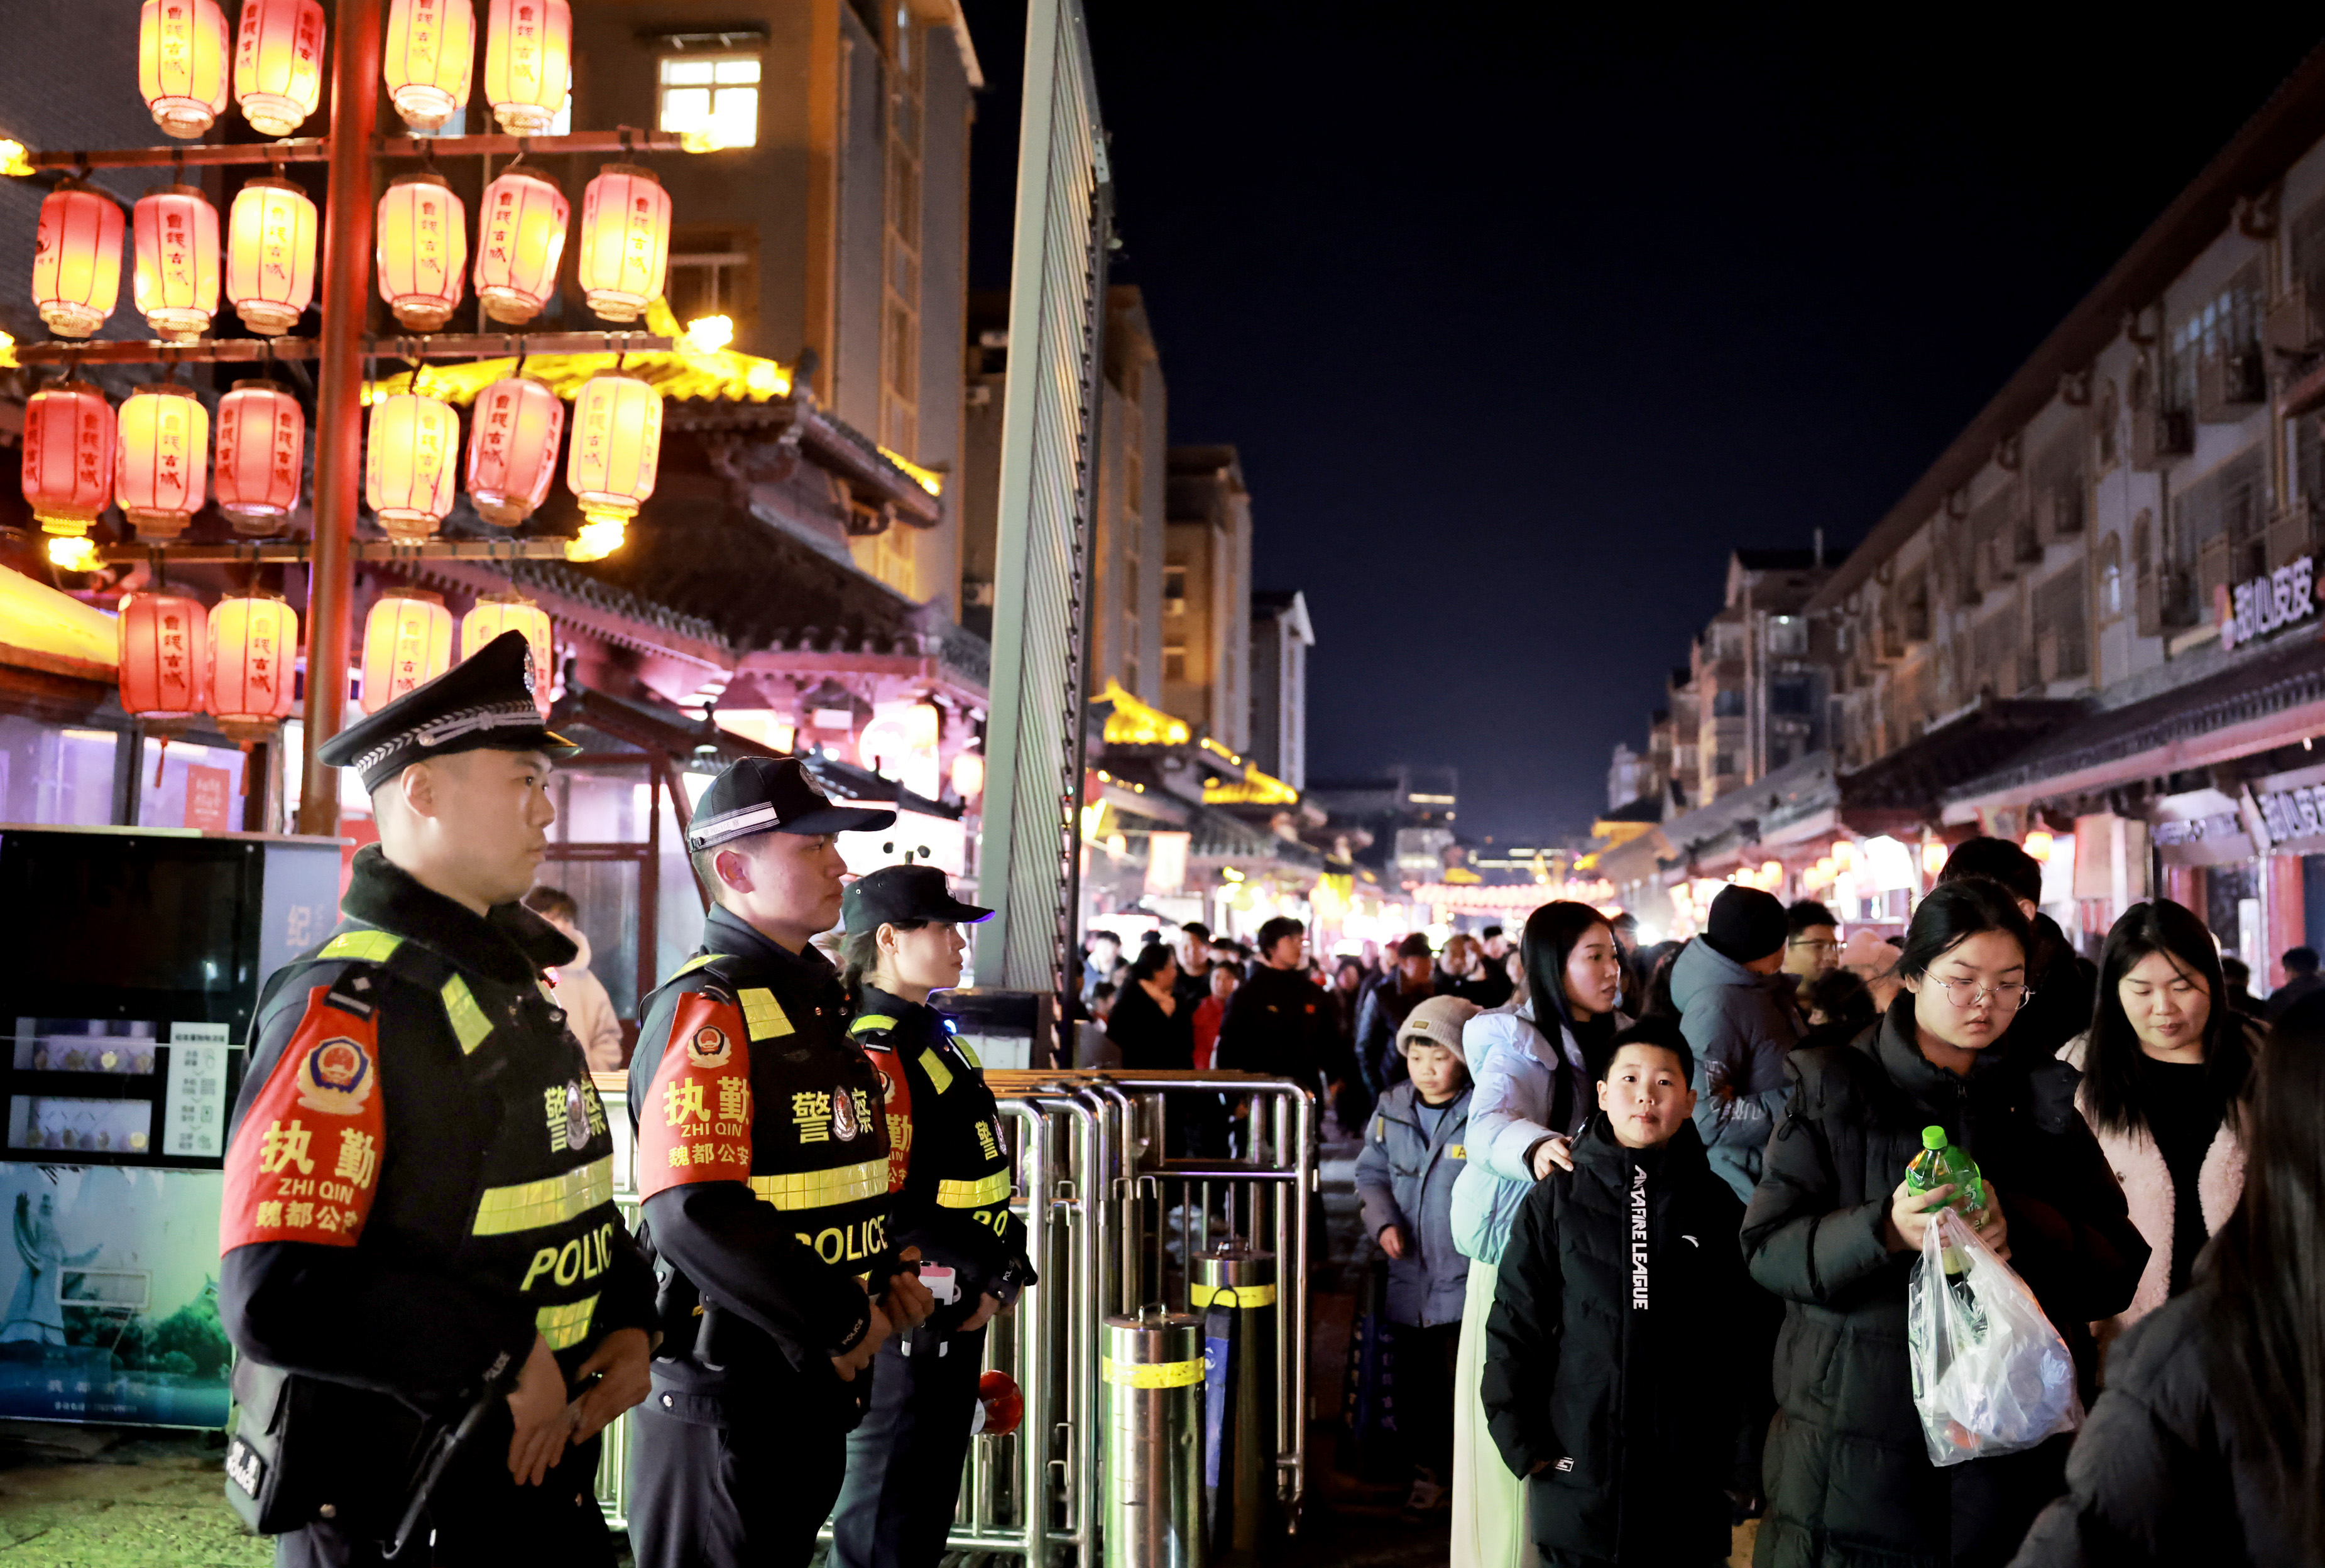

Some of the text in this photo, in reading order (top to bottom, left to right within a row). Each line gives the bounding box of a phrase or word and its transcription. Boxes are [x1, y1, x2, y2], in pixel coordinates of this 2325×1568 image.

[710, 822, 731, 834] POLICE
[544, 1079, 606, 1153] 警察
[663, 1076, 750, 1126] 执勤
[792, 1087, 873, 1144] 警察
[681, 1122, 742, 1138] ZHI QIN
[886, 1114, 913, 1152] 勤
[975, 1120, 998, 1161] 警
[260, 1119, 375, 1189] 执勤
[669, 1143, 748, 1168] 魏都公安
[278, 1178, 354, 1205] ZHI QIN
[520, 1222, 613, 1292] POLIC
[1632, 1243, 1648, 1310] LEAGUE
